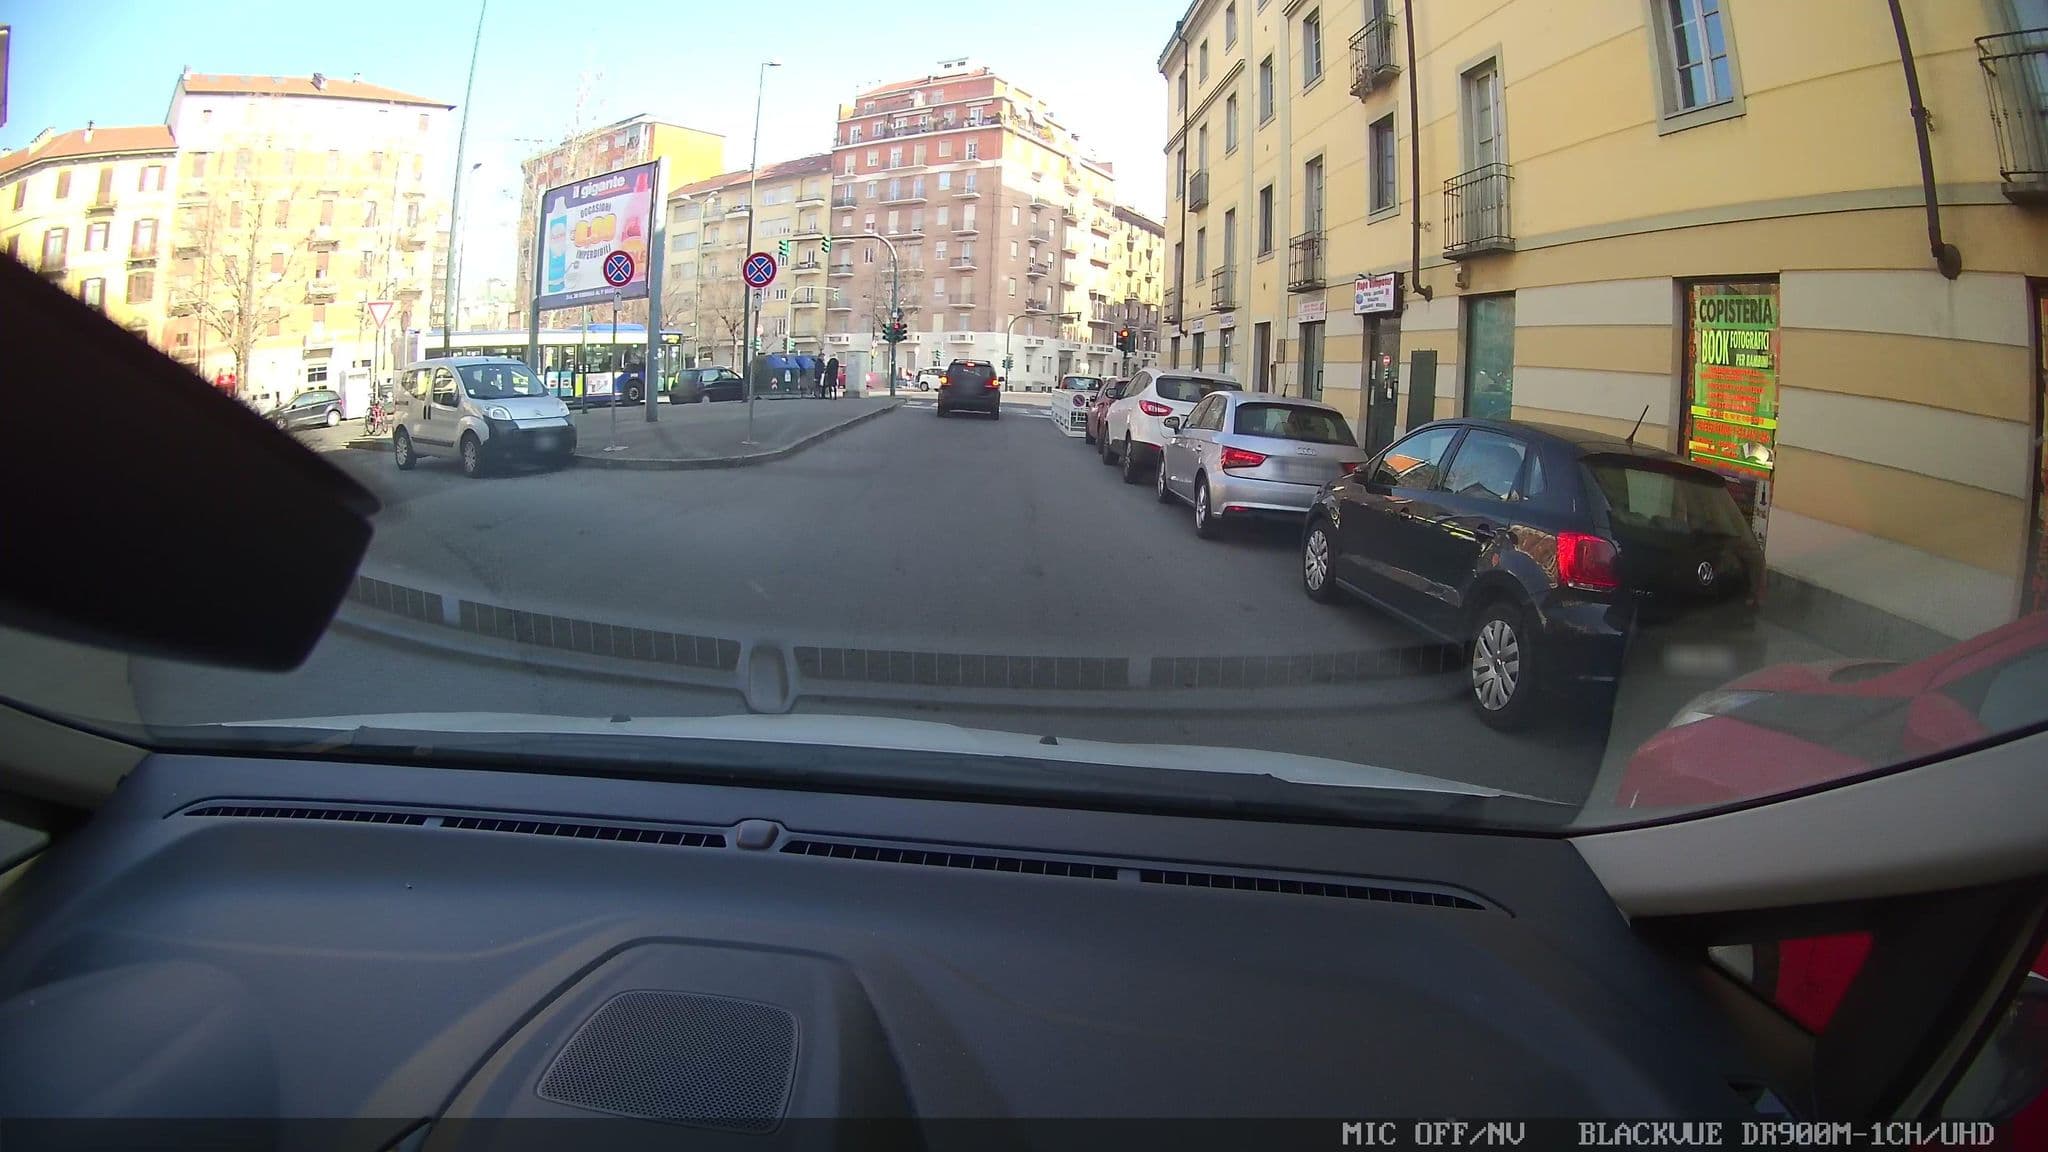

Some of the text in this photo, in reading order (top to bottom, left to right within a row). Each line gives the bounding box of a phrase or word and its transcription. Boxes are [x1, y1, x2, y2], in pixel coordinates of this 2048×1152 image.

[582, 175, 626, 199] gigante
[1699, 298, 1774, 324] COPISTERIA
[1701, 329, 1730, 365] BOOK
[1730, 330, 1769, 350] FOTOGRAFICI
[1735, 353, 1746, 366] PER
